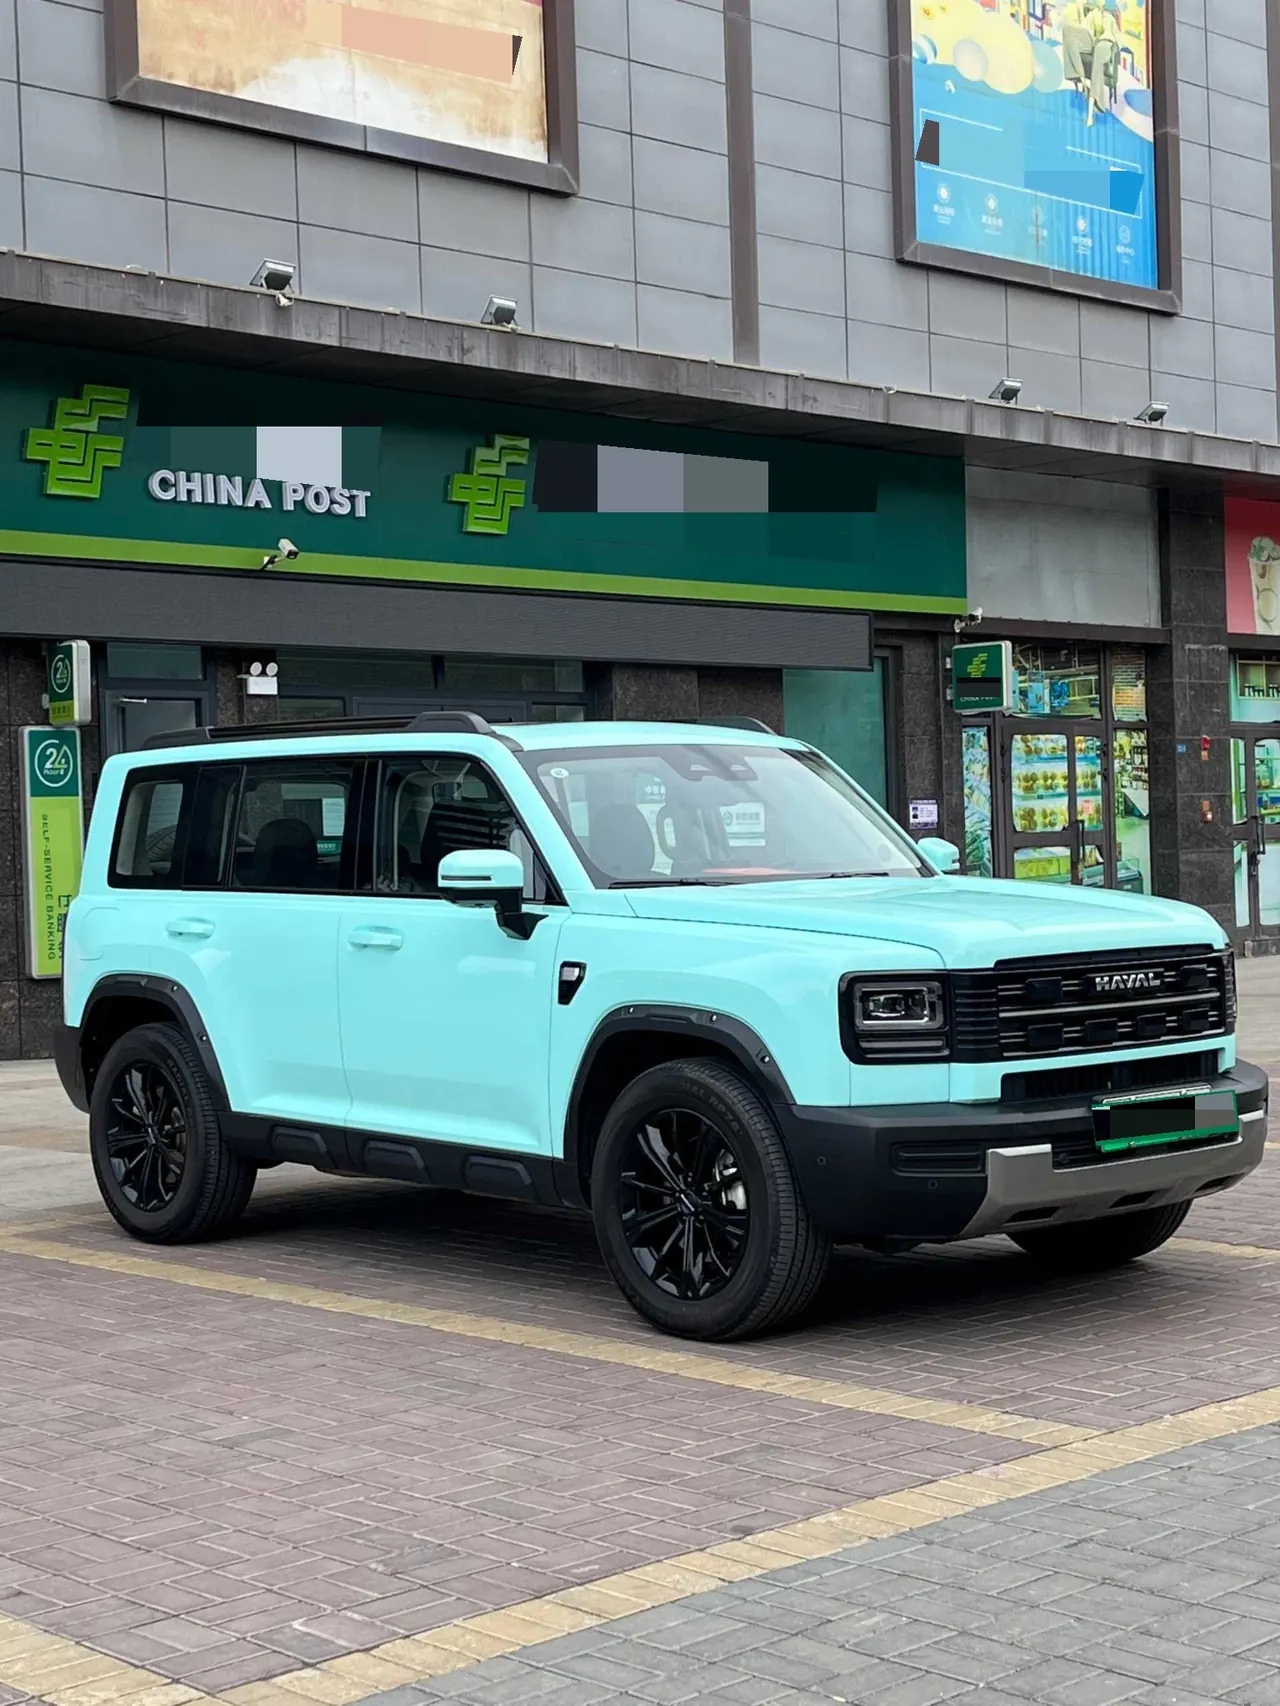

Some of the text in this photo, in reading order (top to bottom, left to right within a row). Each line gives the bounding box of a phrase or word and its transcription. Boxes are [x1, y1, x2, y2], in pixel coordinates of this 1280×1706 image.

[148, 469, 371, 518] CHINA POST
[44, 745, 68, 769] 24
[42, 813, 56, 960] SELF-SERVICE BANKING
[1095, 972, 1161, 992] HAVAL
